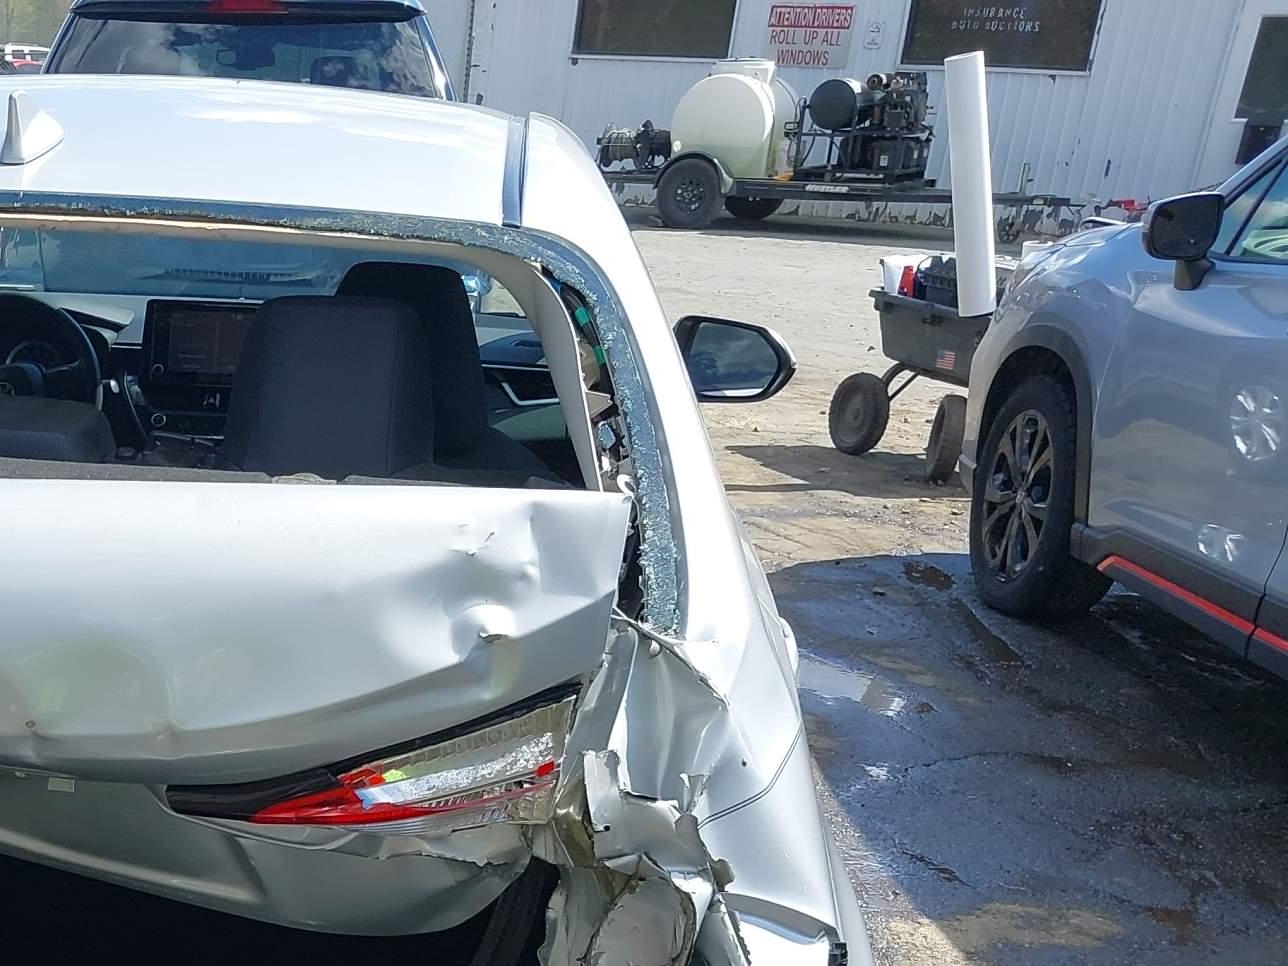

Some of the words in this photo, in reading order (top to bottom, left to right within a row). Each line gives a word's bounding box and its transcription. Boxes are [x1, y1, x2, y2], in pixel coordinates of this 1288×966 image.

[769, 7, 814, 26] ATTENTION
[815, 8, 852, 27] DRIVERS
[963, 7, 1027, 19] INSURANCE
[984, 20, 1041, 32] AUCTIONS
[770, 29, 797, 45] ROLL
[803, 30, 819, 46] UP
[821, 31, 842, 46] ALL
[776, 49, 829, 66] WINDOWS
